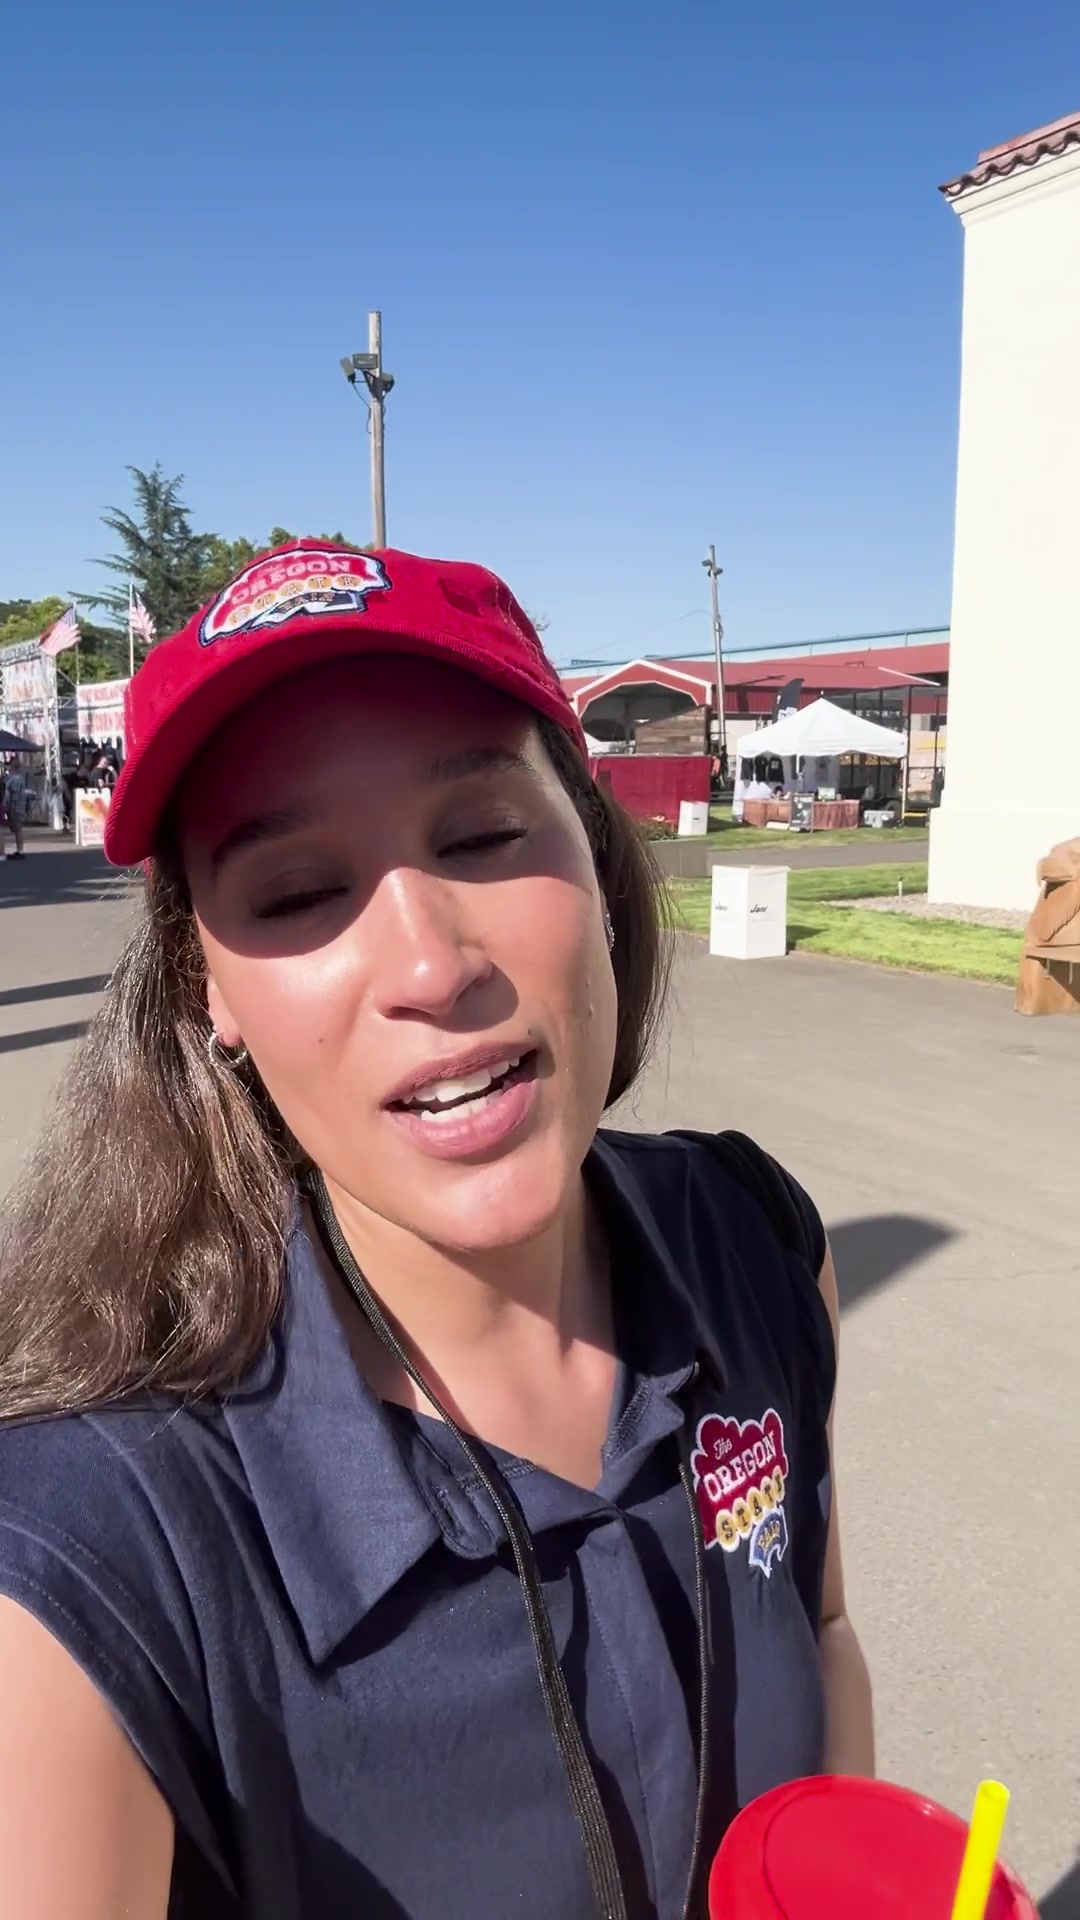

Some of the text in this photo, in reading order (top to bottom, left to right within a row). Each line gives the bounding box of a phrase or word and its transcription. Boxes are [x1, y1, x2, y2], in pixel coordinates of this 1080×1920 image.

[231, 560, 351, 604] OREGON
[232, 575, 359, 623] STATE
[703, 1430, 777, 1502] OREGON
[713, 1437, 733, 1460] The
[719, 1471, 784, 1545] STATE
